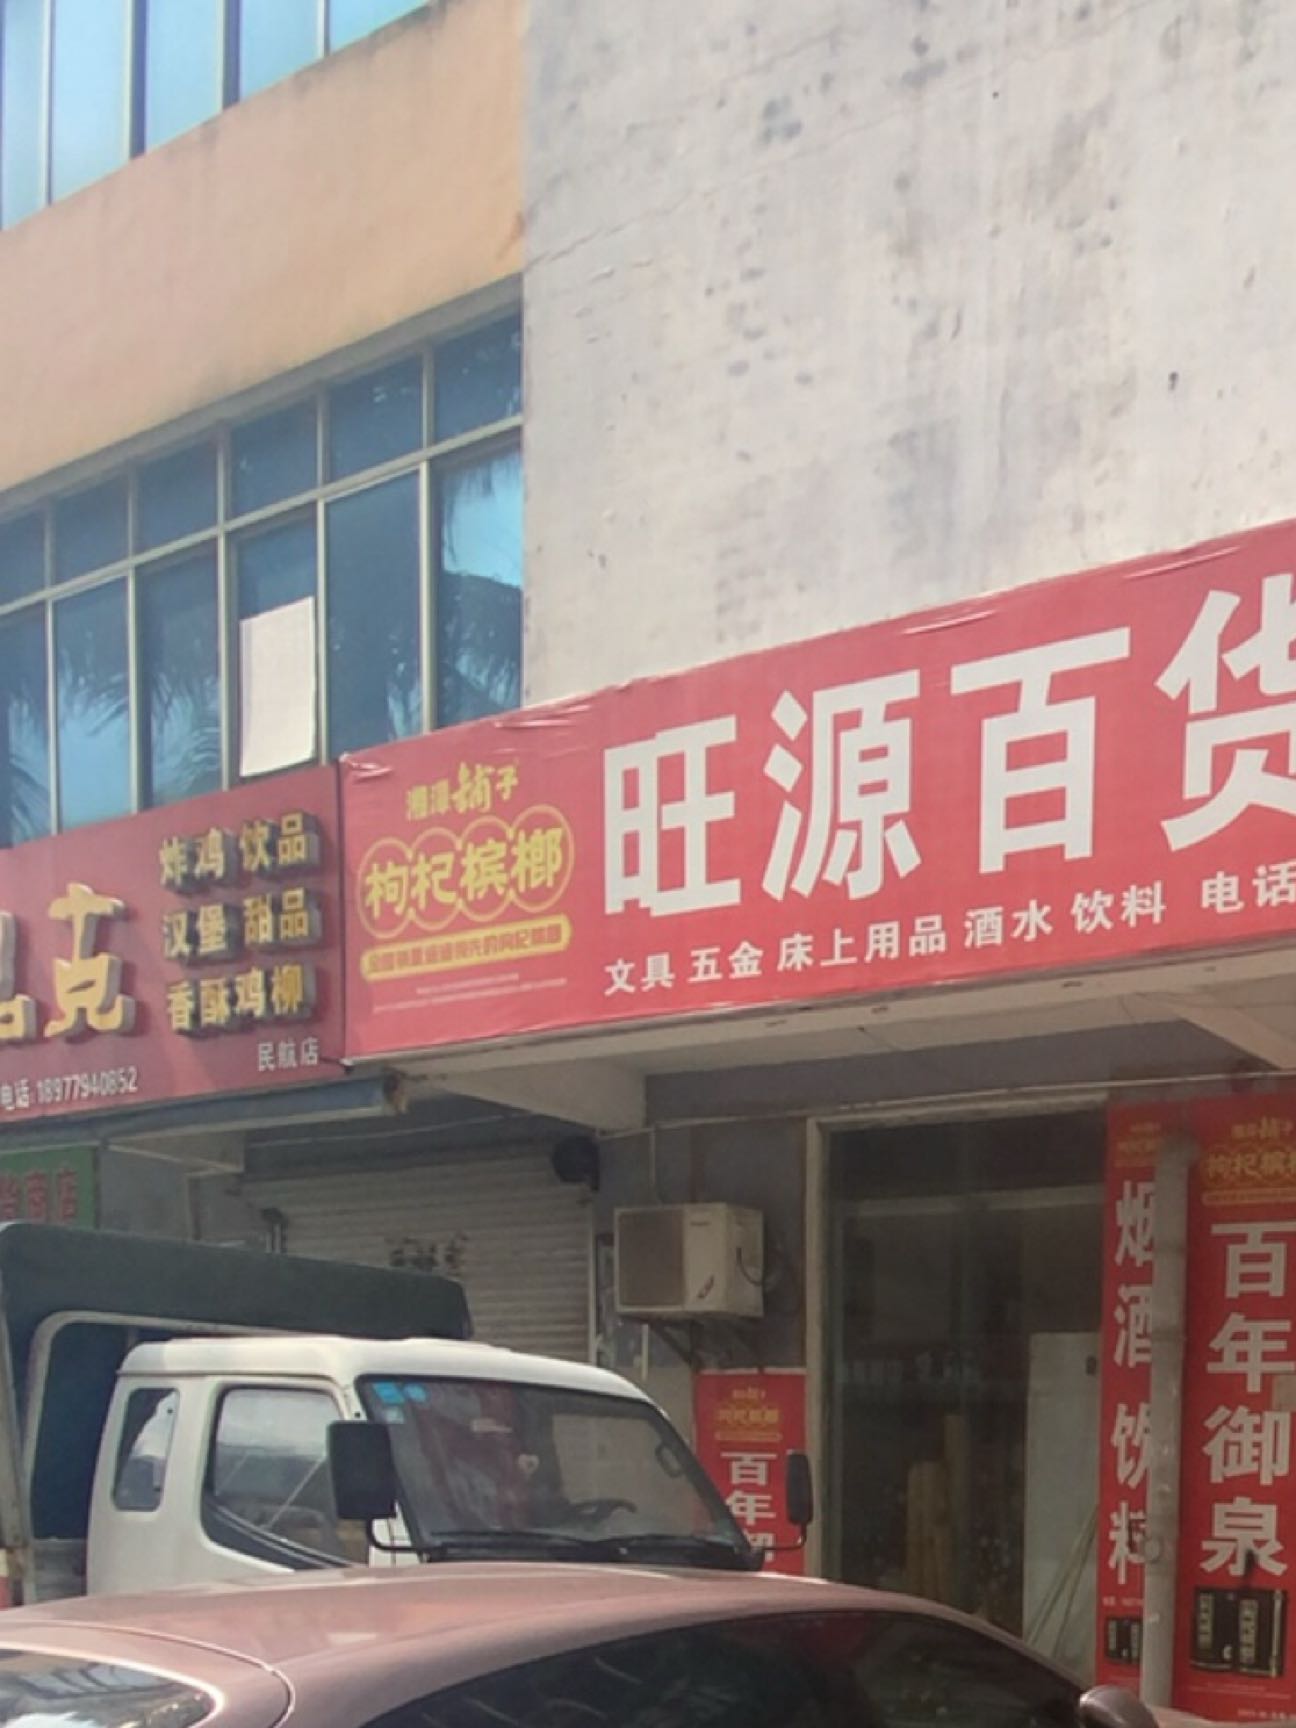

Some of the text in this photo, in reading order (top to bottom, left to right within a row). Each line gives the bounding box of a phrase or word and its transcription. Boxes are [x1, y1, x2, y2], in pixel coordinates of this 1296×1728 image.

[159, 811, 306, 885] 炸鸡 饮品
[365, 827, 562, 919] 枸杞槟榔
[0, 882, 127, 1040] 克
[163, 887, 309, 960] 汉堡 甜品
[604, 953, 674, 996] 文具
[688, 941, 763, 983] 五金
[777, 914, 947, 972] 床上用品
[964, 900, 1053, 949] 酒水
[1071, 881, 1167, 934] 饮料
[167, 963, 306, 1031] 香酥鸡柳
